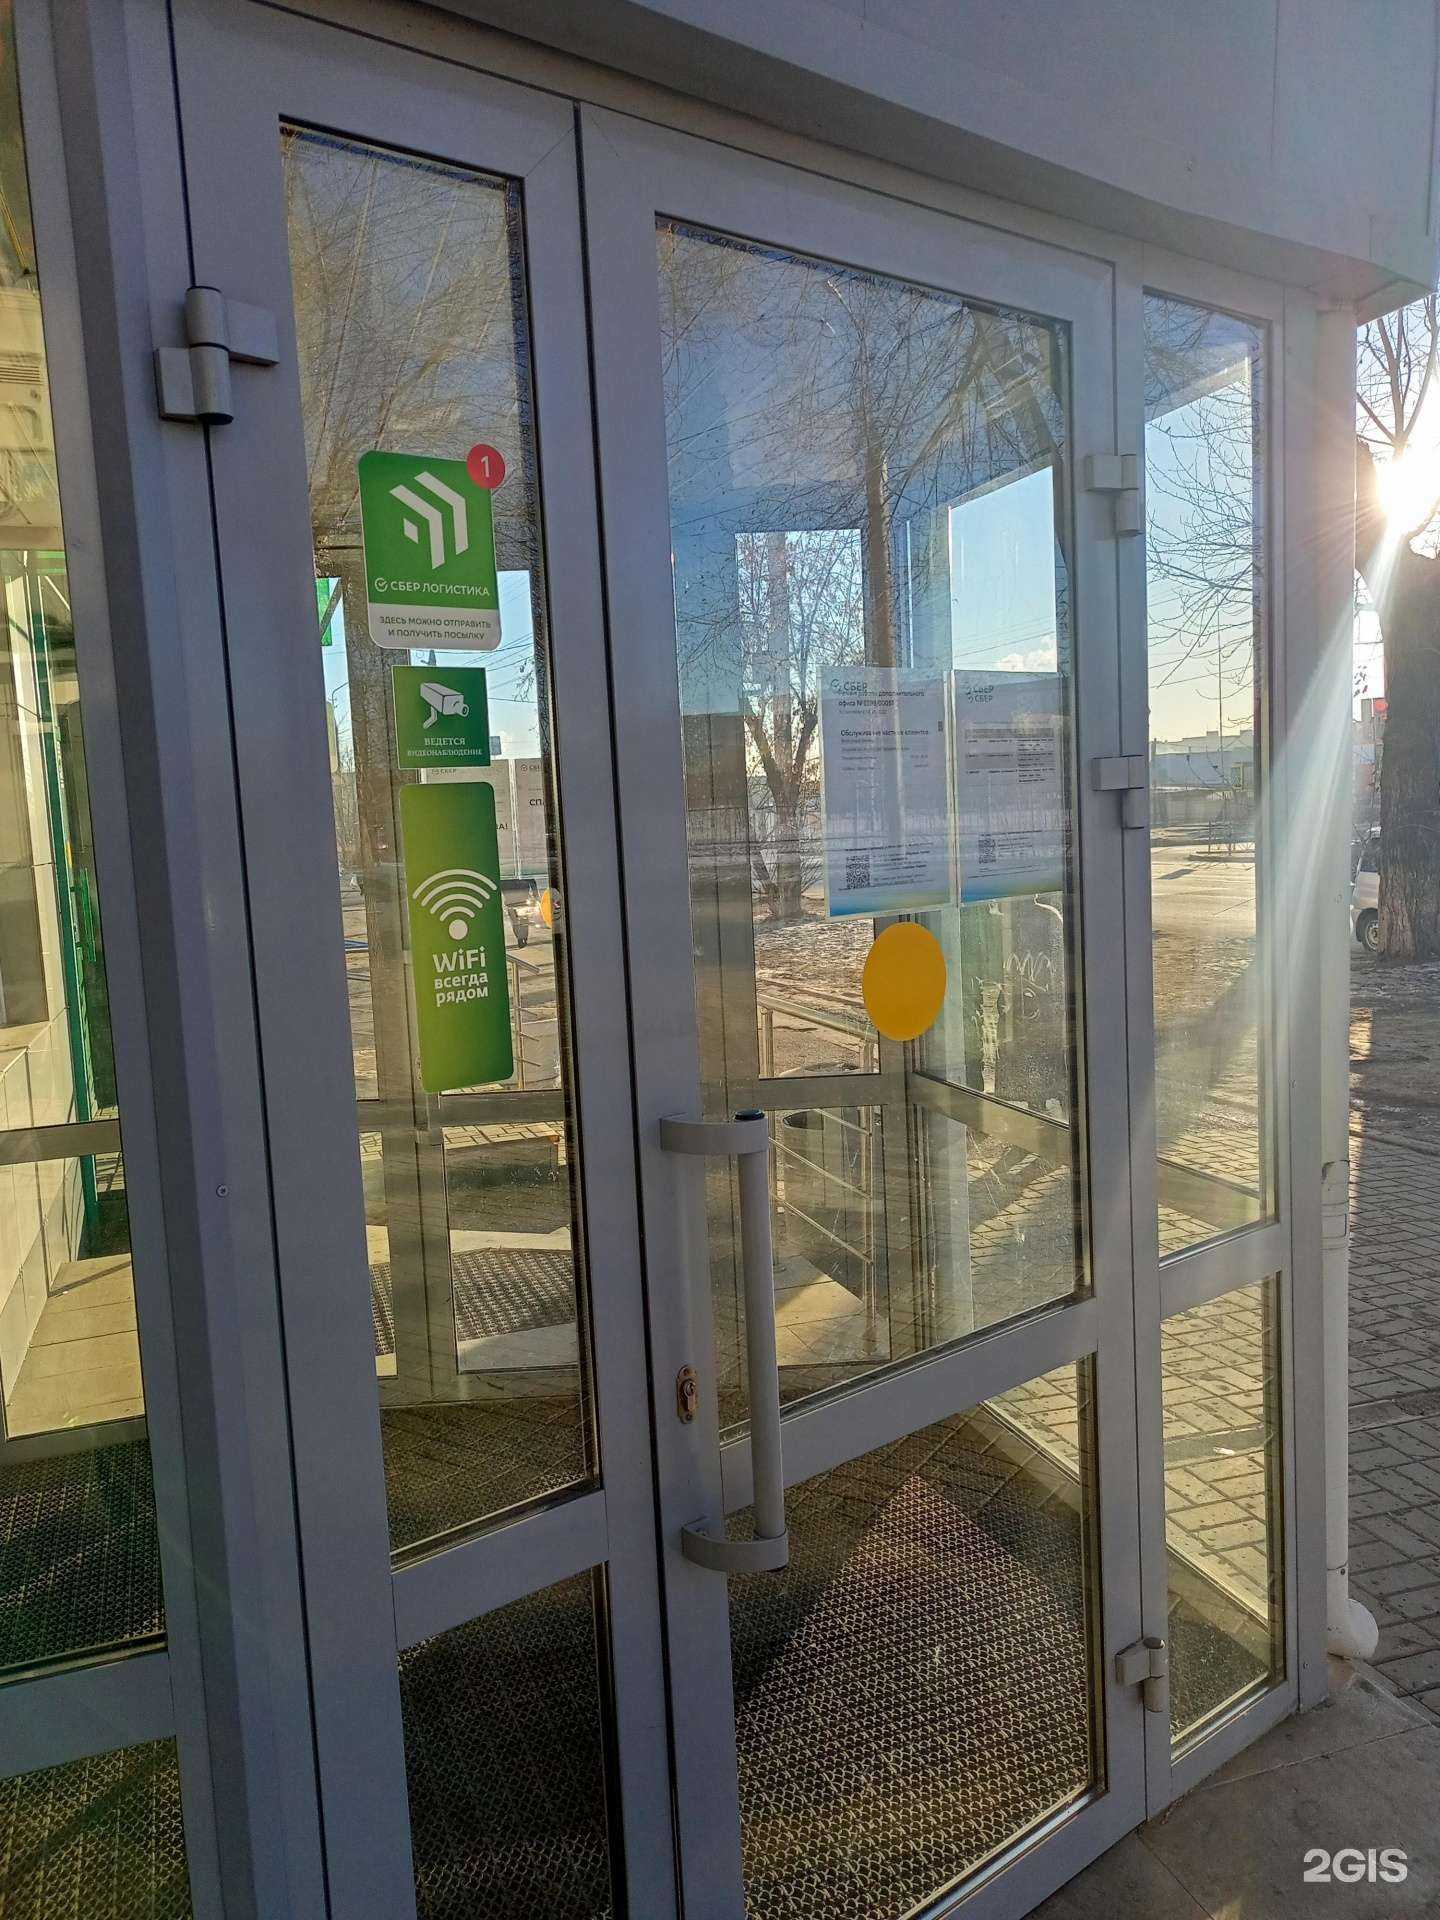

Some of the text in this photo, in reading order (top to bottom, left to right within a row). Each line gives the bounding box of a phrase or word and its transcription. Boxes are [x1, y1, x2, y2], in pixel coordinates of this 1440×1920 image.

[480, 455, 490, 478] 1
[390, 580, 491, 597] СБЕР ЛОГИСТИКА
[379, 616, 492, 629] ЗДЕСЬ МОЖНО ОТПРАВИТЬ
[388, 629, 486, 640] И ПОЛУЧИТЬ ПОСЫЛКУ
[424, 737, 466, 747] ВЕДЕТСЯ
[432, 945, 487, 974] WiFi
[433, 971, 489, 990] всегда
[435, 986, 489, 1008] рядом
